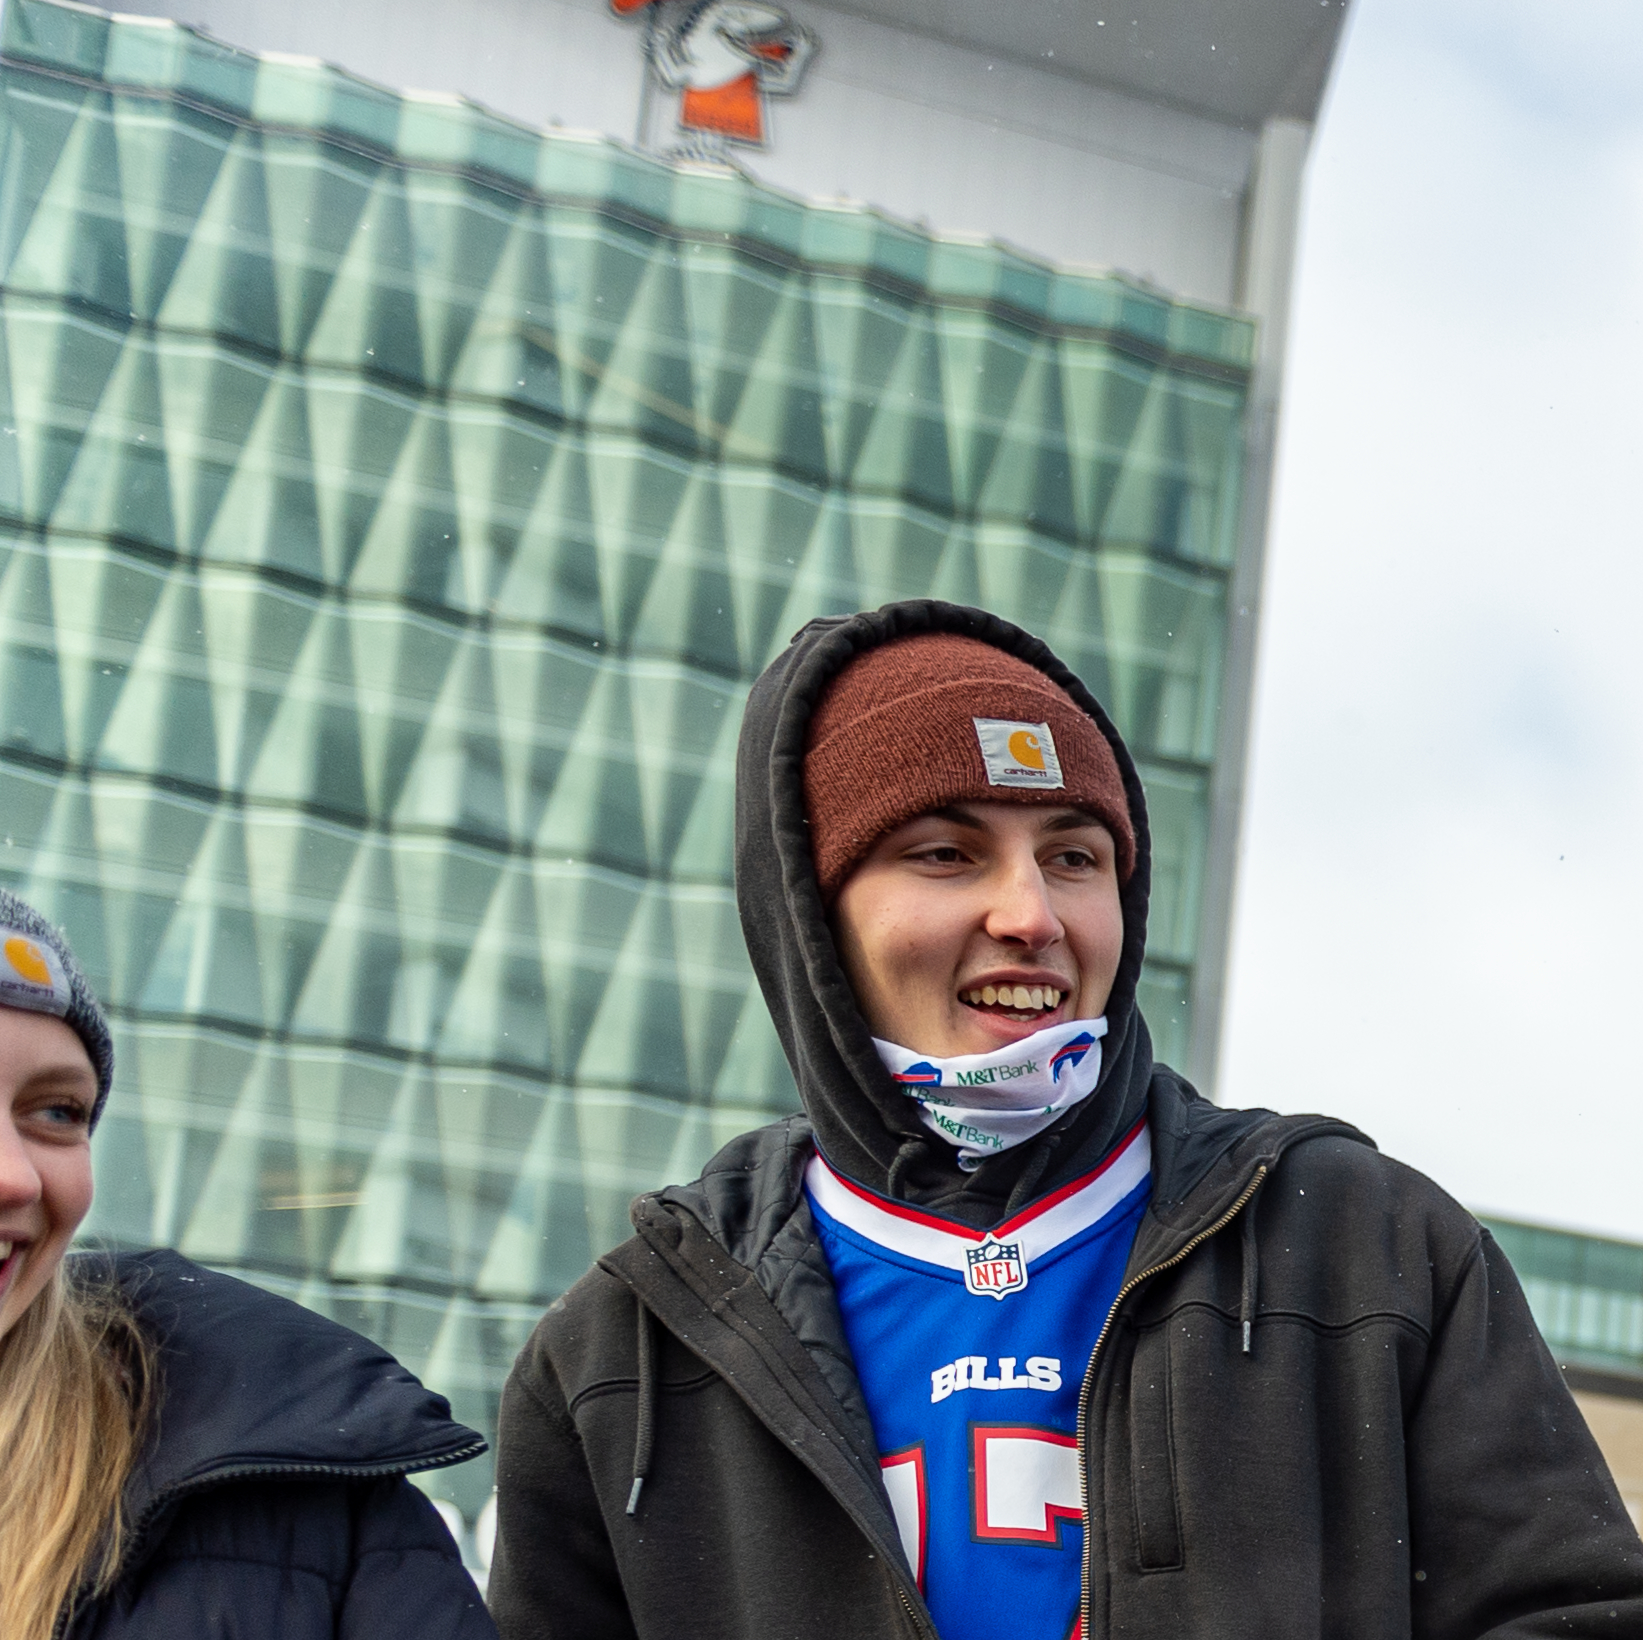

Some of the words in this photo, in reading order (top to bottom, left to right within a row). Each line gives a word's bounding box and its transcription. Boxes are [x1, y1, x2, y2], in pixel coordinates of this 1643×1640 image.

[1004, 768, 1047, 777] carhartt
[956, 1068, 998, 1087] M&T
[999, 1060, 1039, 1081] Bank
[933, 1110, 966, 1138] M&T
[966, 1127, 1005, 1150] Bank
[973, 1261, 1019, 1287] NFL
[930, 1355, 1062, 1404] BILLS
